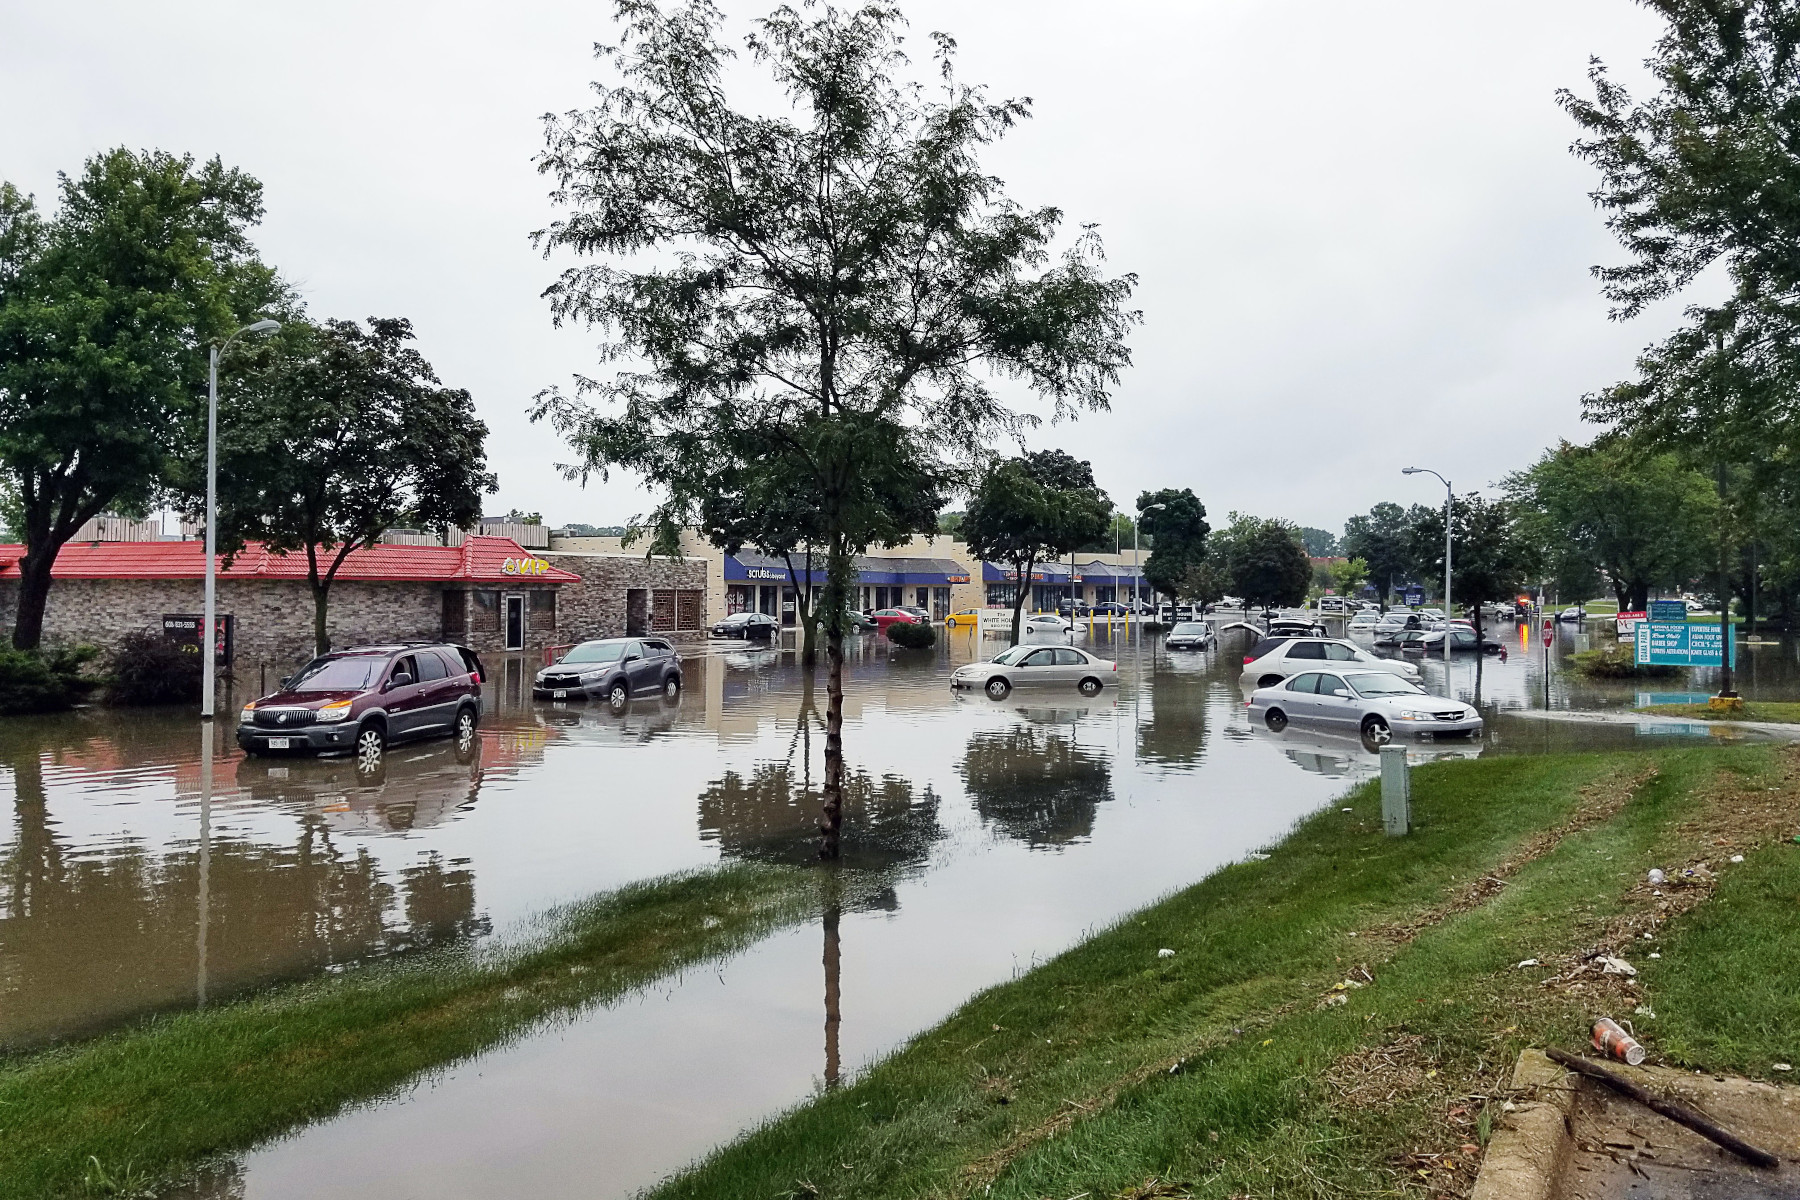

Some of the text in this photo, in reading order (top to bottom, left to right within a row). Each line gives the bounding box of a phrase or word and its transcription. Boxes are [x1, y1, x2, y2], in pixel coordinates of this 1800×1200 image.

[516, 558, 550, 575] VIP
[748, 567, 769, 578] scrubs
[728, 592, 744, 604] sale
[1544, 628, 1552, 639] STOP
